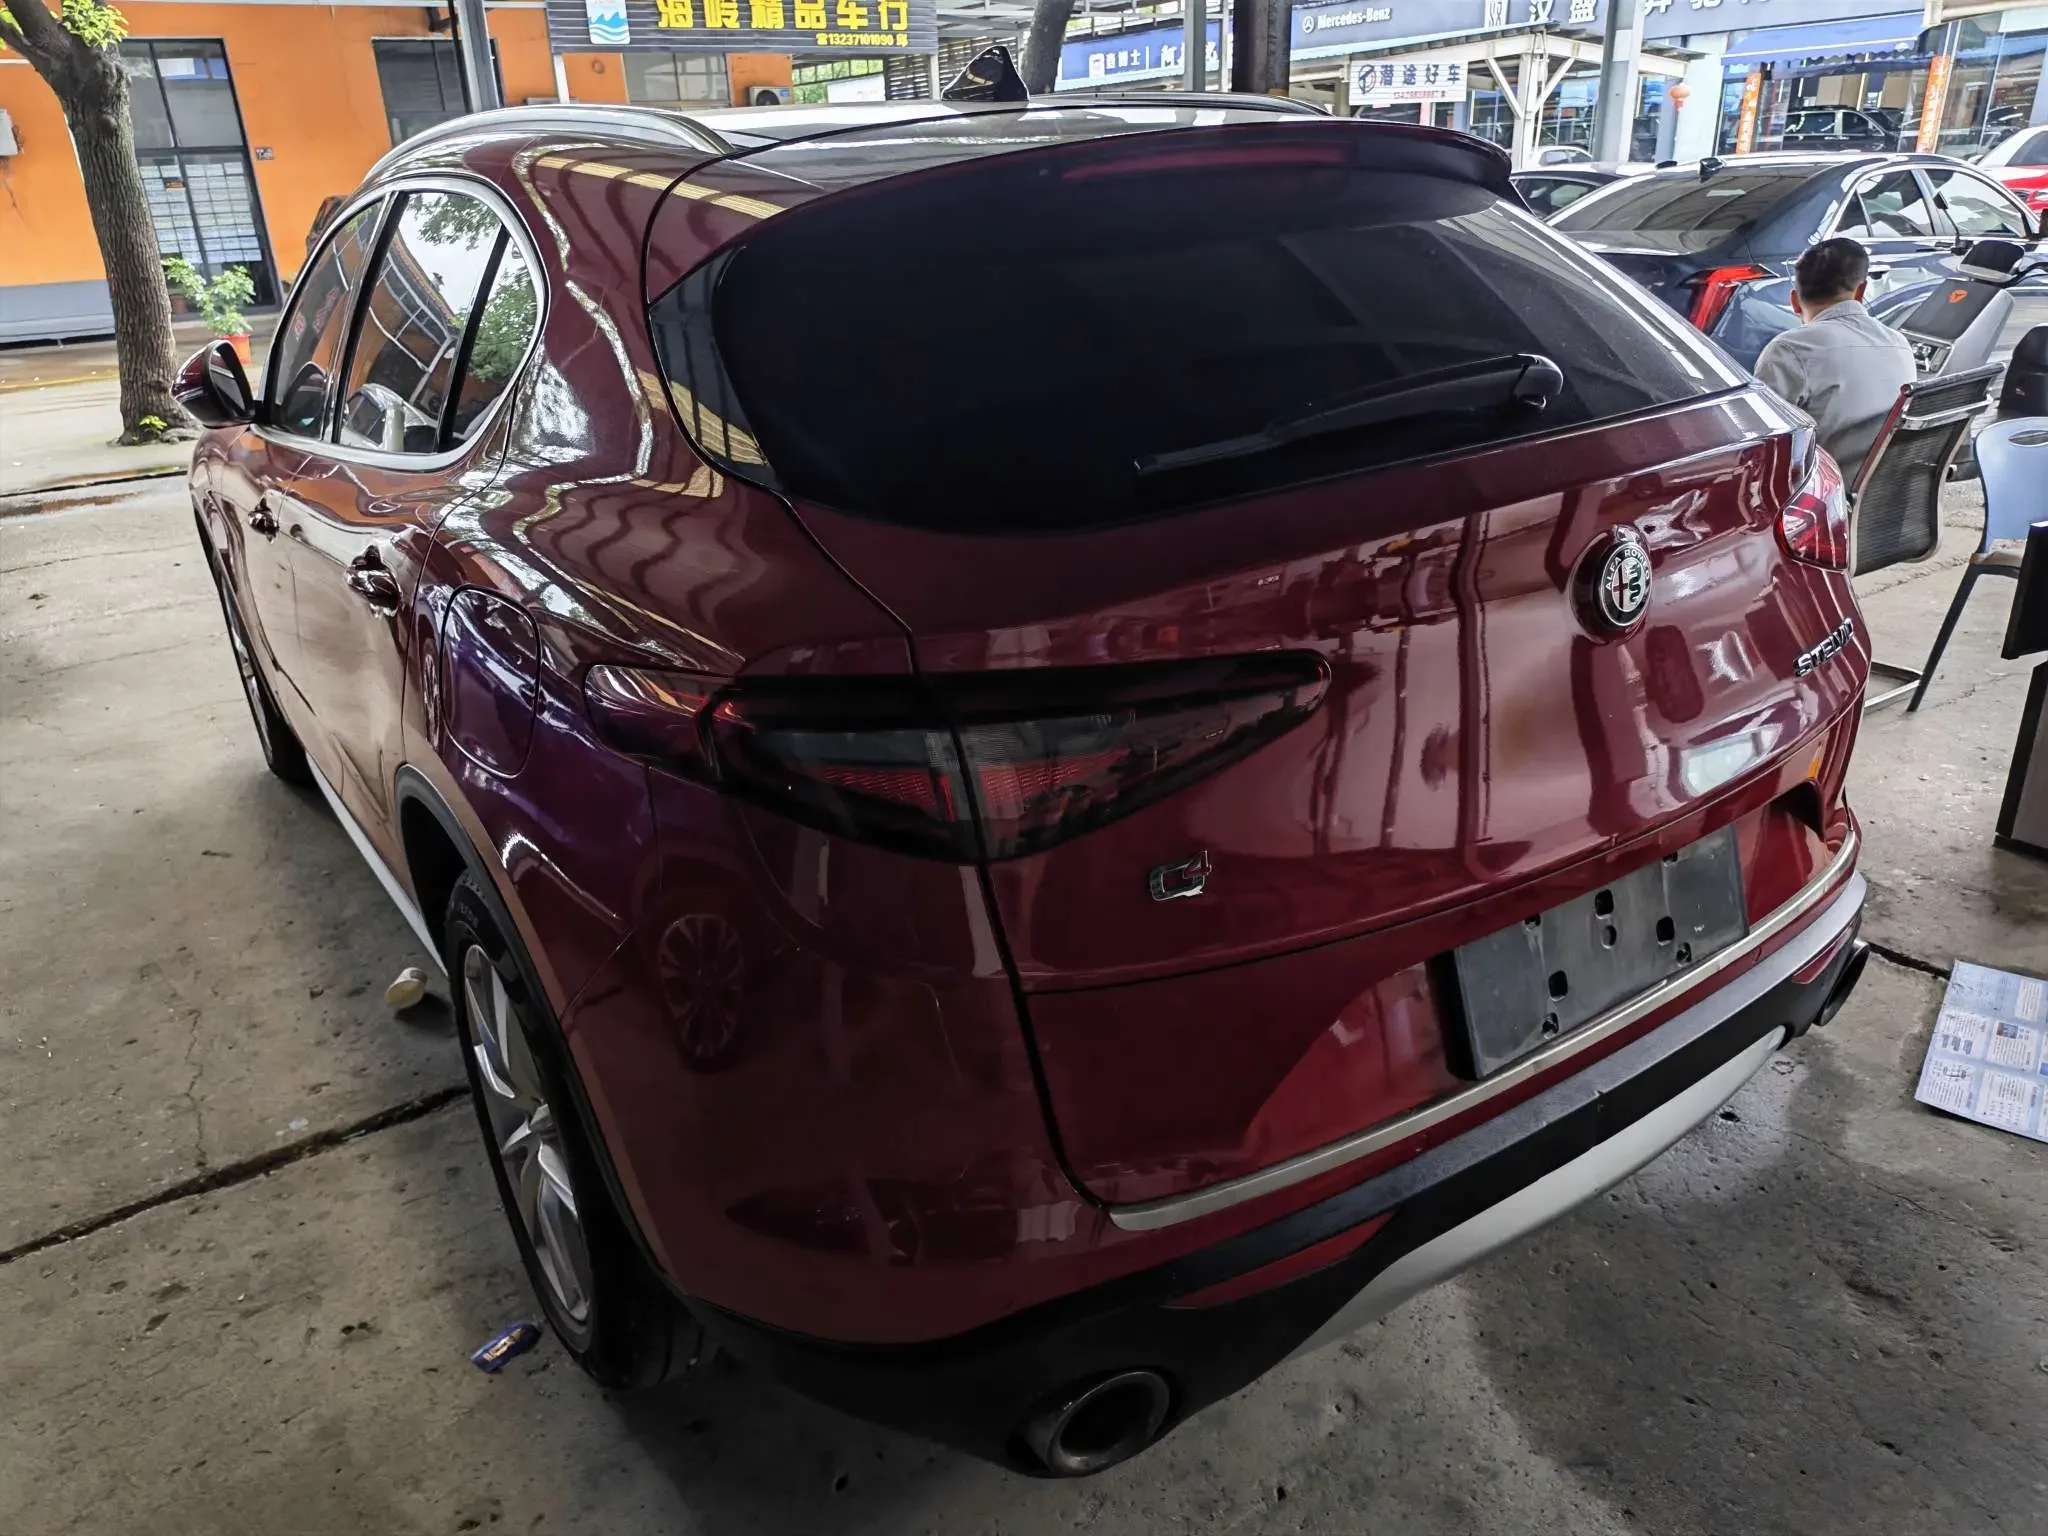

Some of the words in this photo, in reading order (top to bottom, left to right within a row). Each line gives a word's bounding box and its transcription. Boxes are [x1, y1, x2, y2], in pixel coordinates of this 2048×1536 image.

[1317, 8, 1391, 29] Mercedes-Benz
[1380, 63, 1461, 86] 潜途好车
[1605, 556, 1622, 591] ALFA
